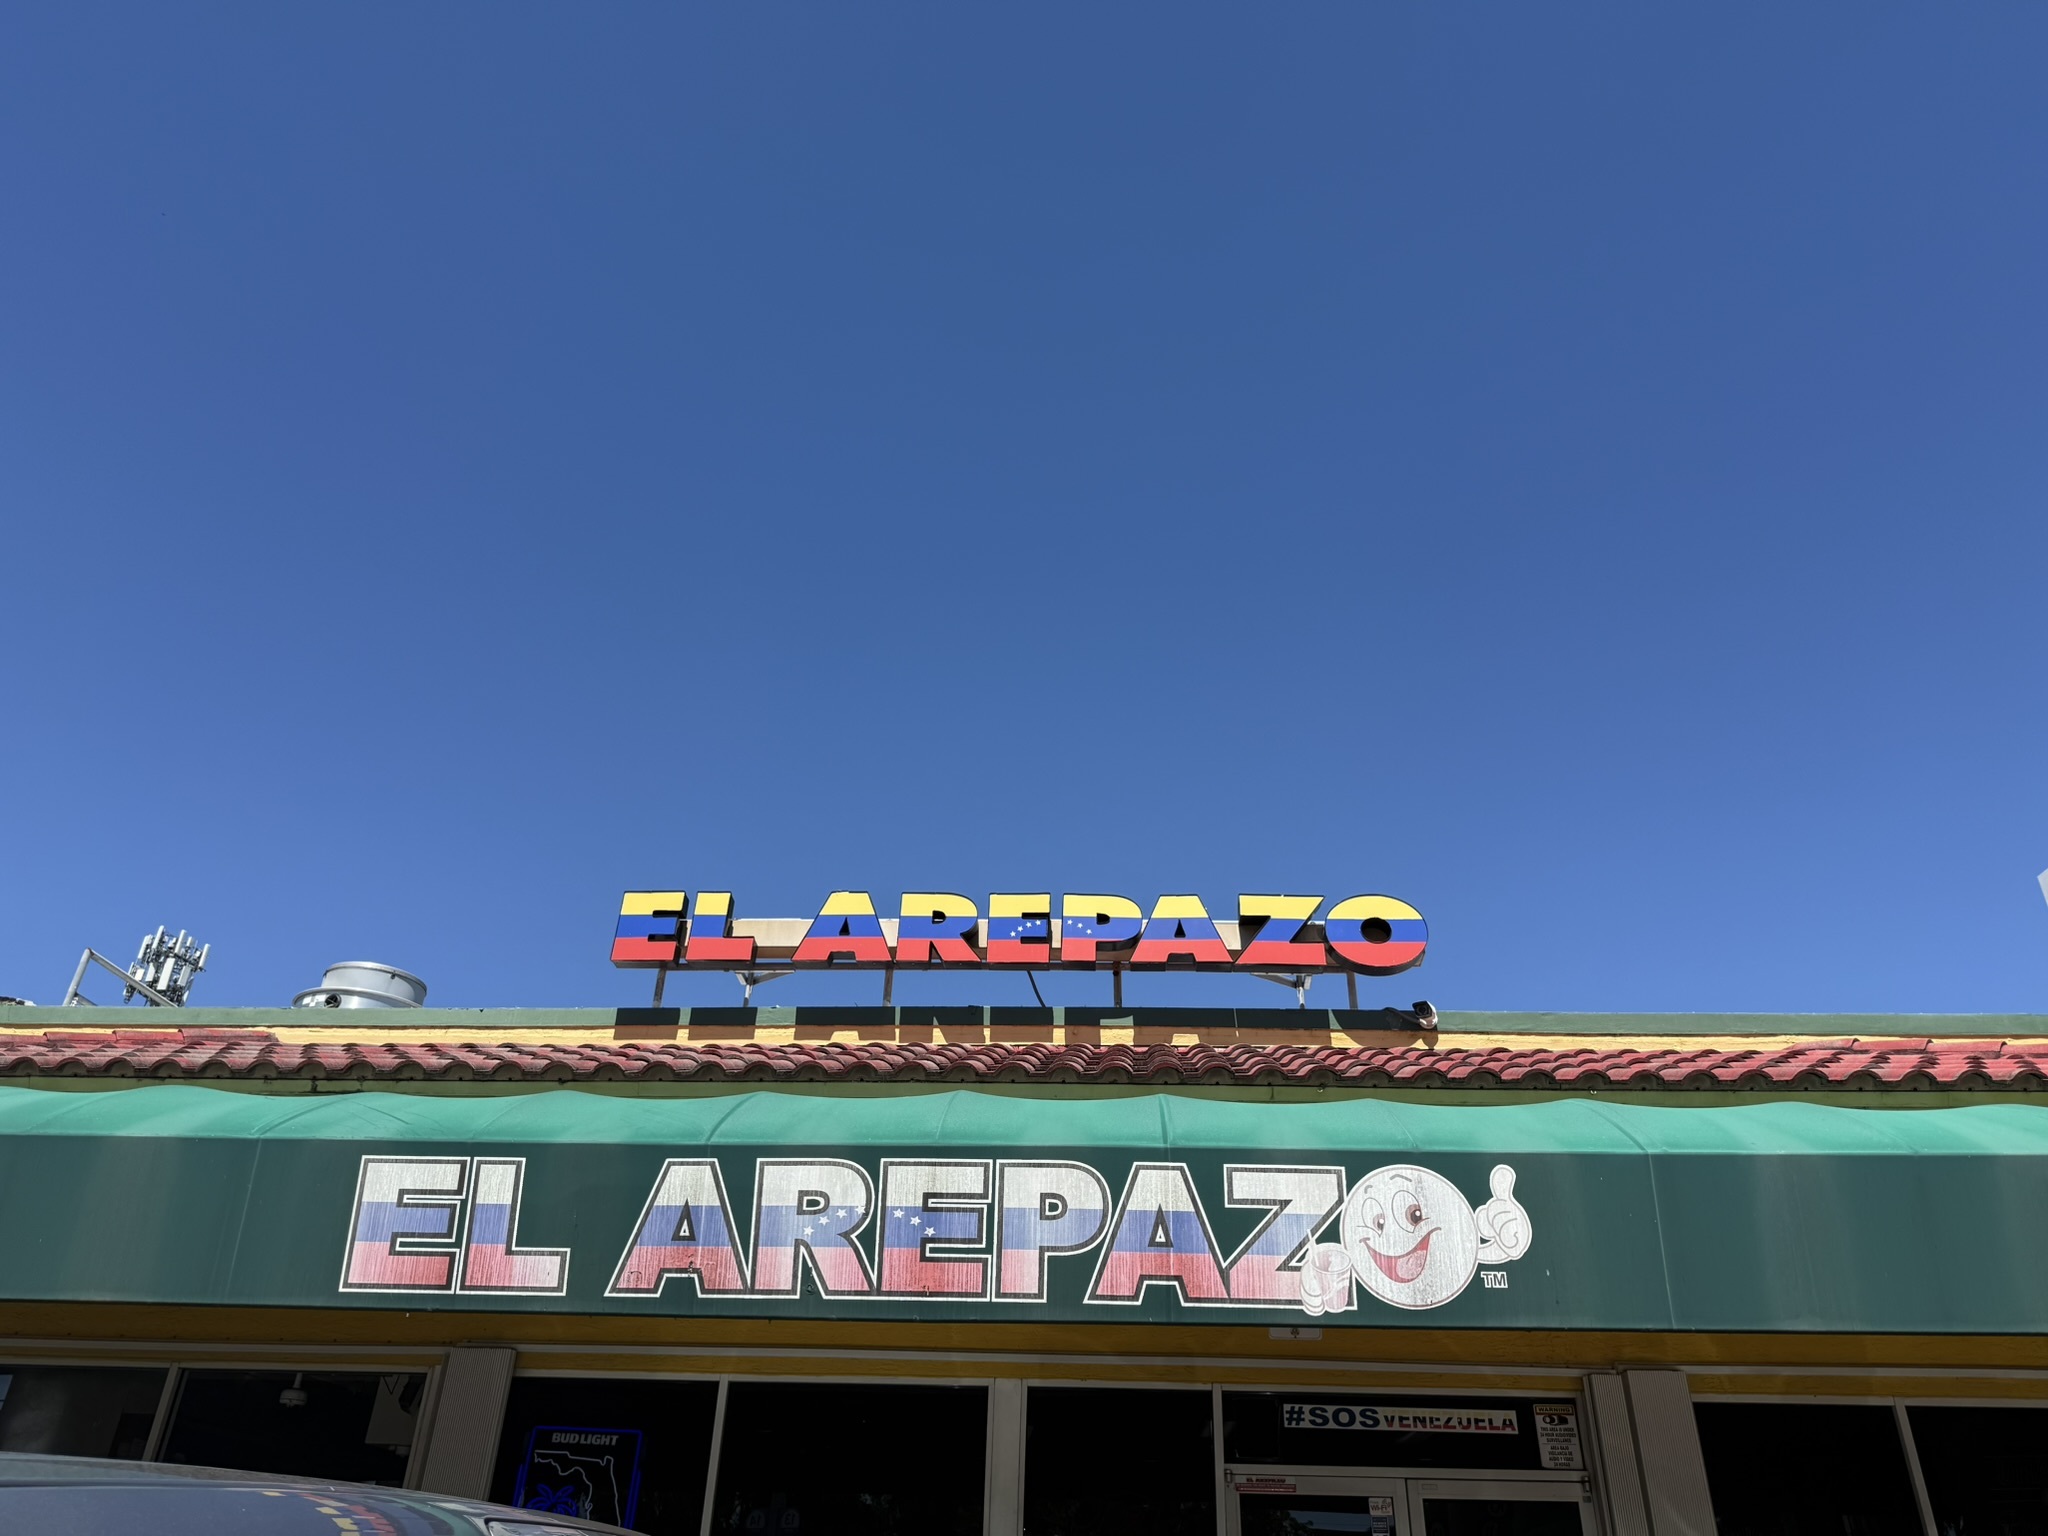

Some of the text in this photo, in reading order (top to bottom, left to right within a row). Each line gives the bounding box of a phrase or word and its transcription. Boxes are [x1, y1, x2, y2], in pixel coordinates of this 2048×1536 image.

[610, 890, 1429, 976] EL AREPAZO
[338, 1155, 572, 1297] EL
[1481, 1271, 1508, 1289] TM
[1285, 1405, 1517, 1432] #SOSVENEZUELA
[552, 1432, 619, 1445] BUD LIGHT
